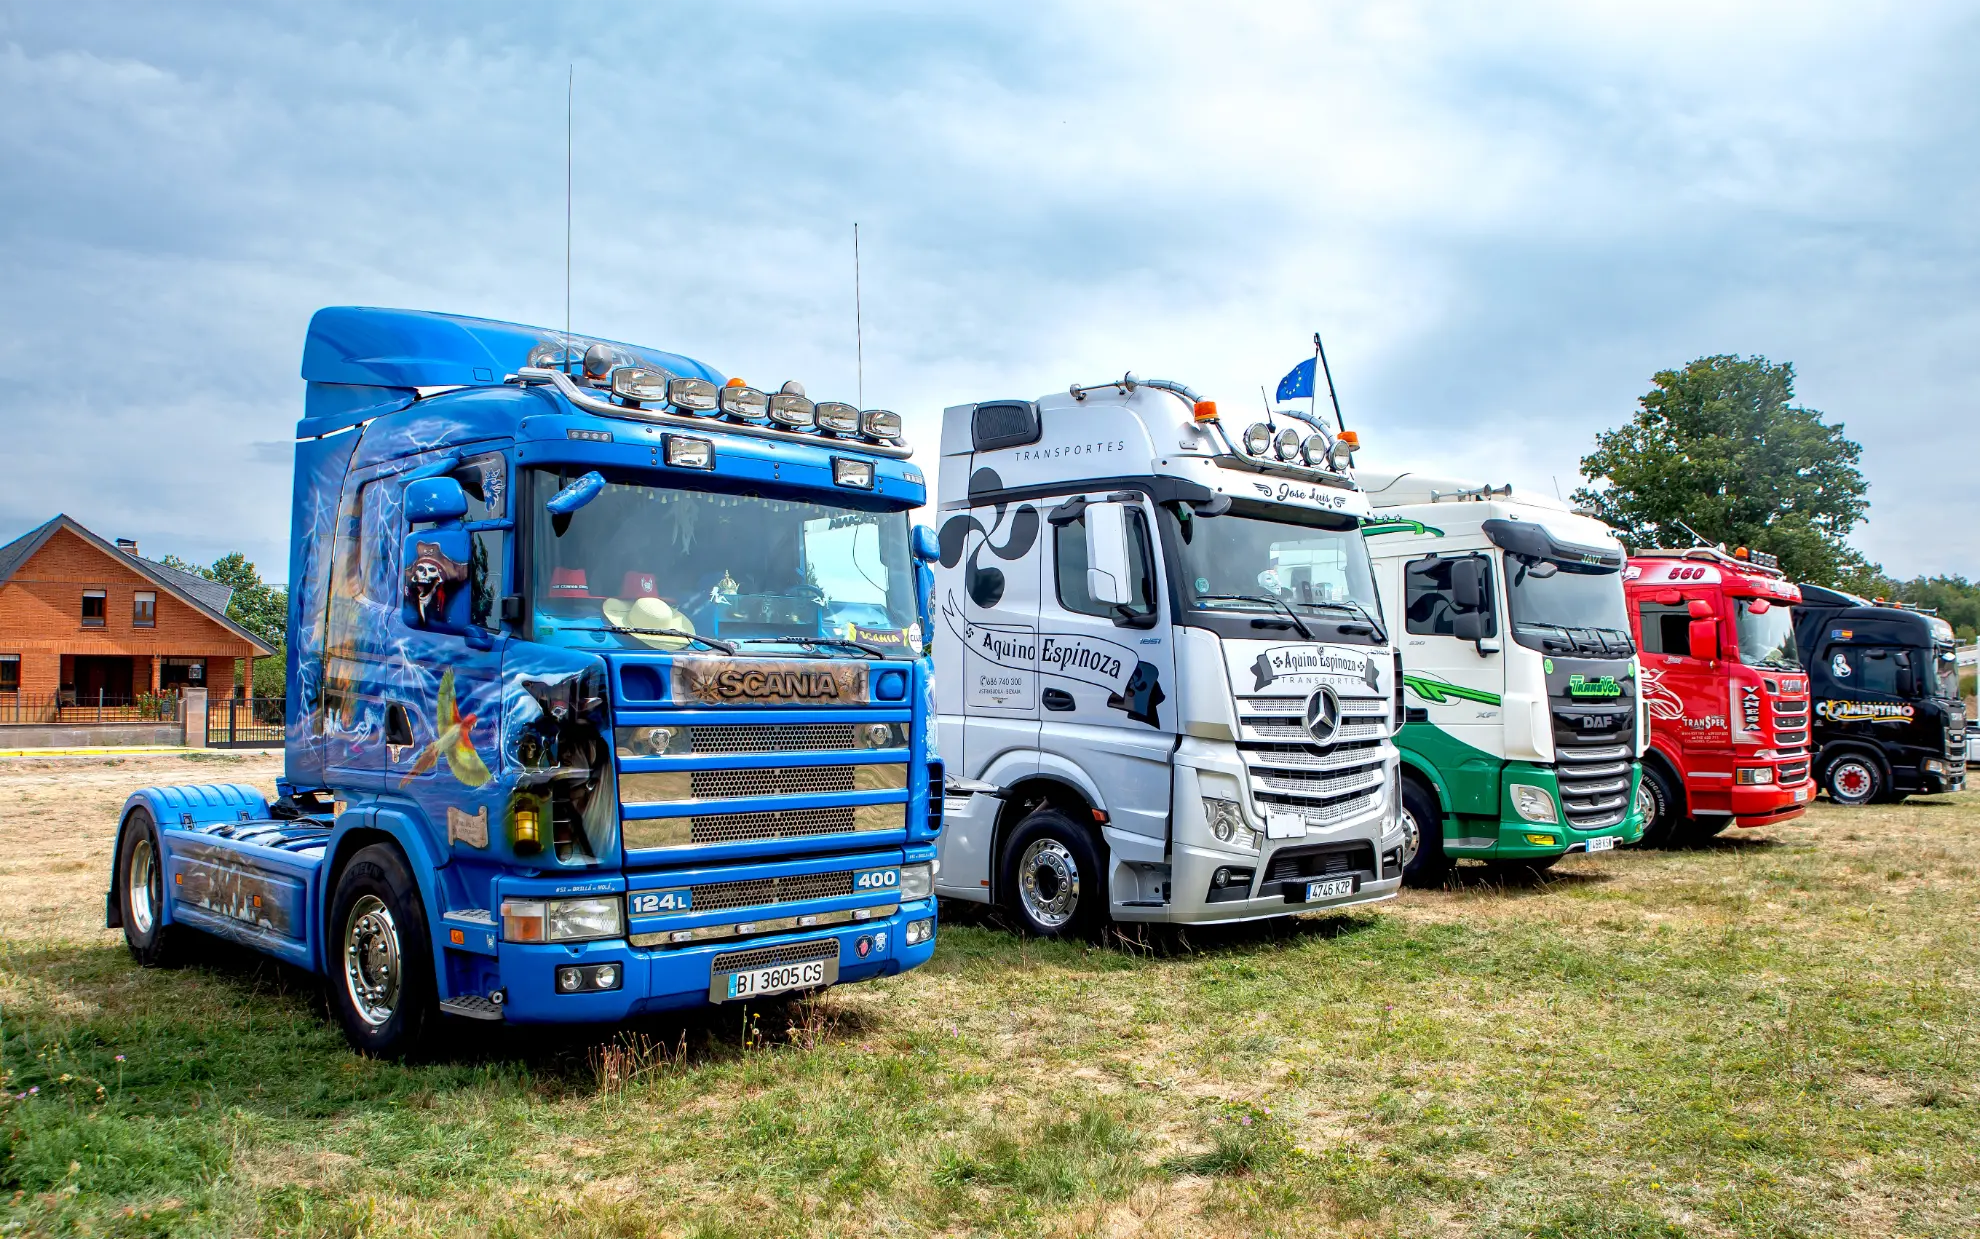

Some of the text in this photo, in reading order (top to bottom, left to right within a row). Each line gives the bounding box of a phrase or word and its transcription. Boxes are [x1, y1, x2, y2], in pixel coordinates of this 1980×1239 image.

[1015, 440, 1124, 461] TRANSPORTES
[1308, 487, 1330, 506] Luis
[1581, 553, 1602, 566] JAVI
[1667, 567, 1706, 580] 560
[859, 630, 901, 643] SCANIA
[982, 632, 1122, 679] Aquino Espinoza
[1284, 651, 1357, 672] Aquino Espinoza
[718, 670, 839, 698] SCANIA
[1281, 676, 1362, 685] TRANSPORTES
[1741, 685, 1762, 732] VANESA
[1583, 715, 1612, 729] DAF
[1644, 774, 1666, 817] RIDGESTONE
[857, 870, 896, 888] 400
[1312, 880, 1350, 898] 4746 KZP
[633, 893, 687, 913] 124L
[737, 963, 822, 994] BI 3605 CS
